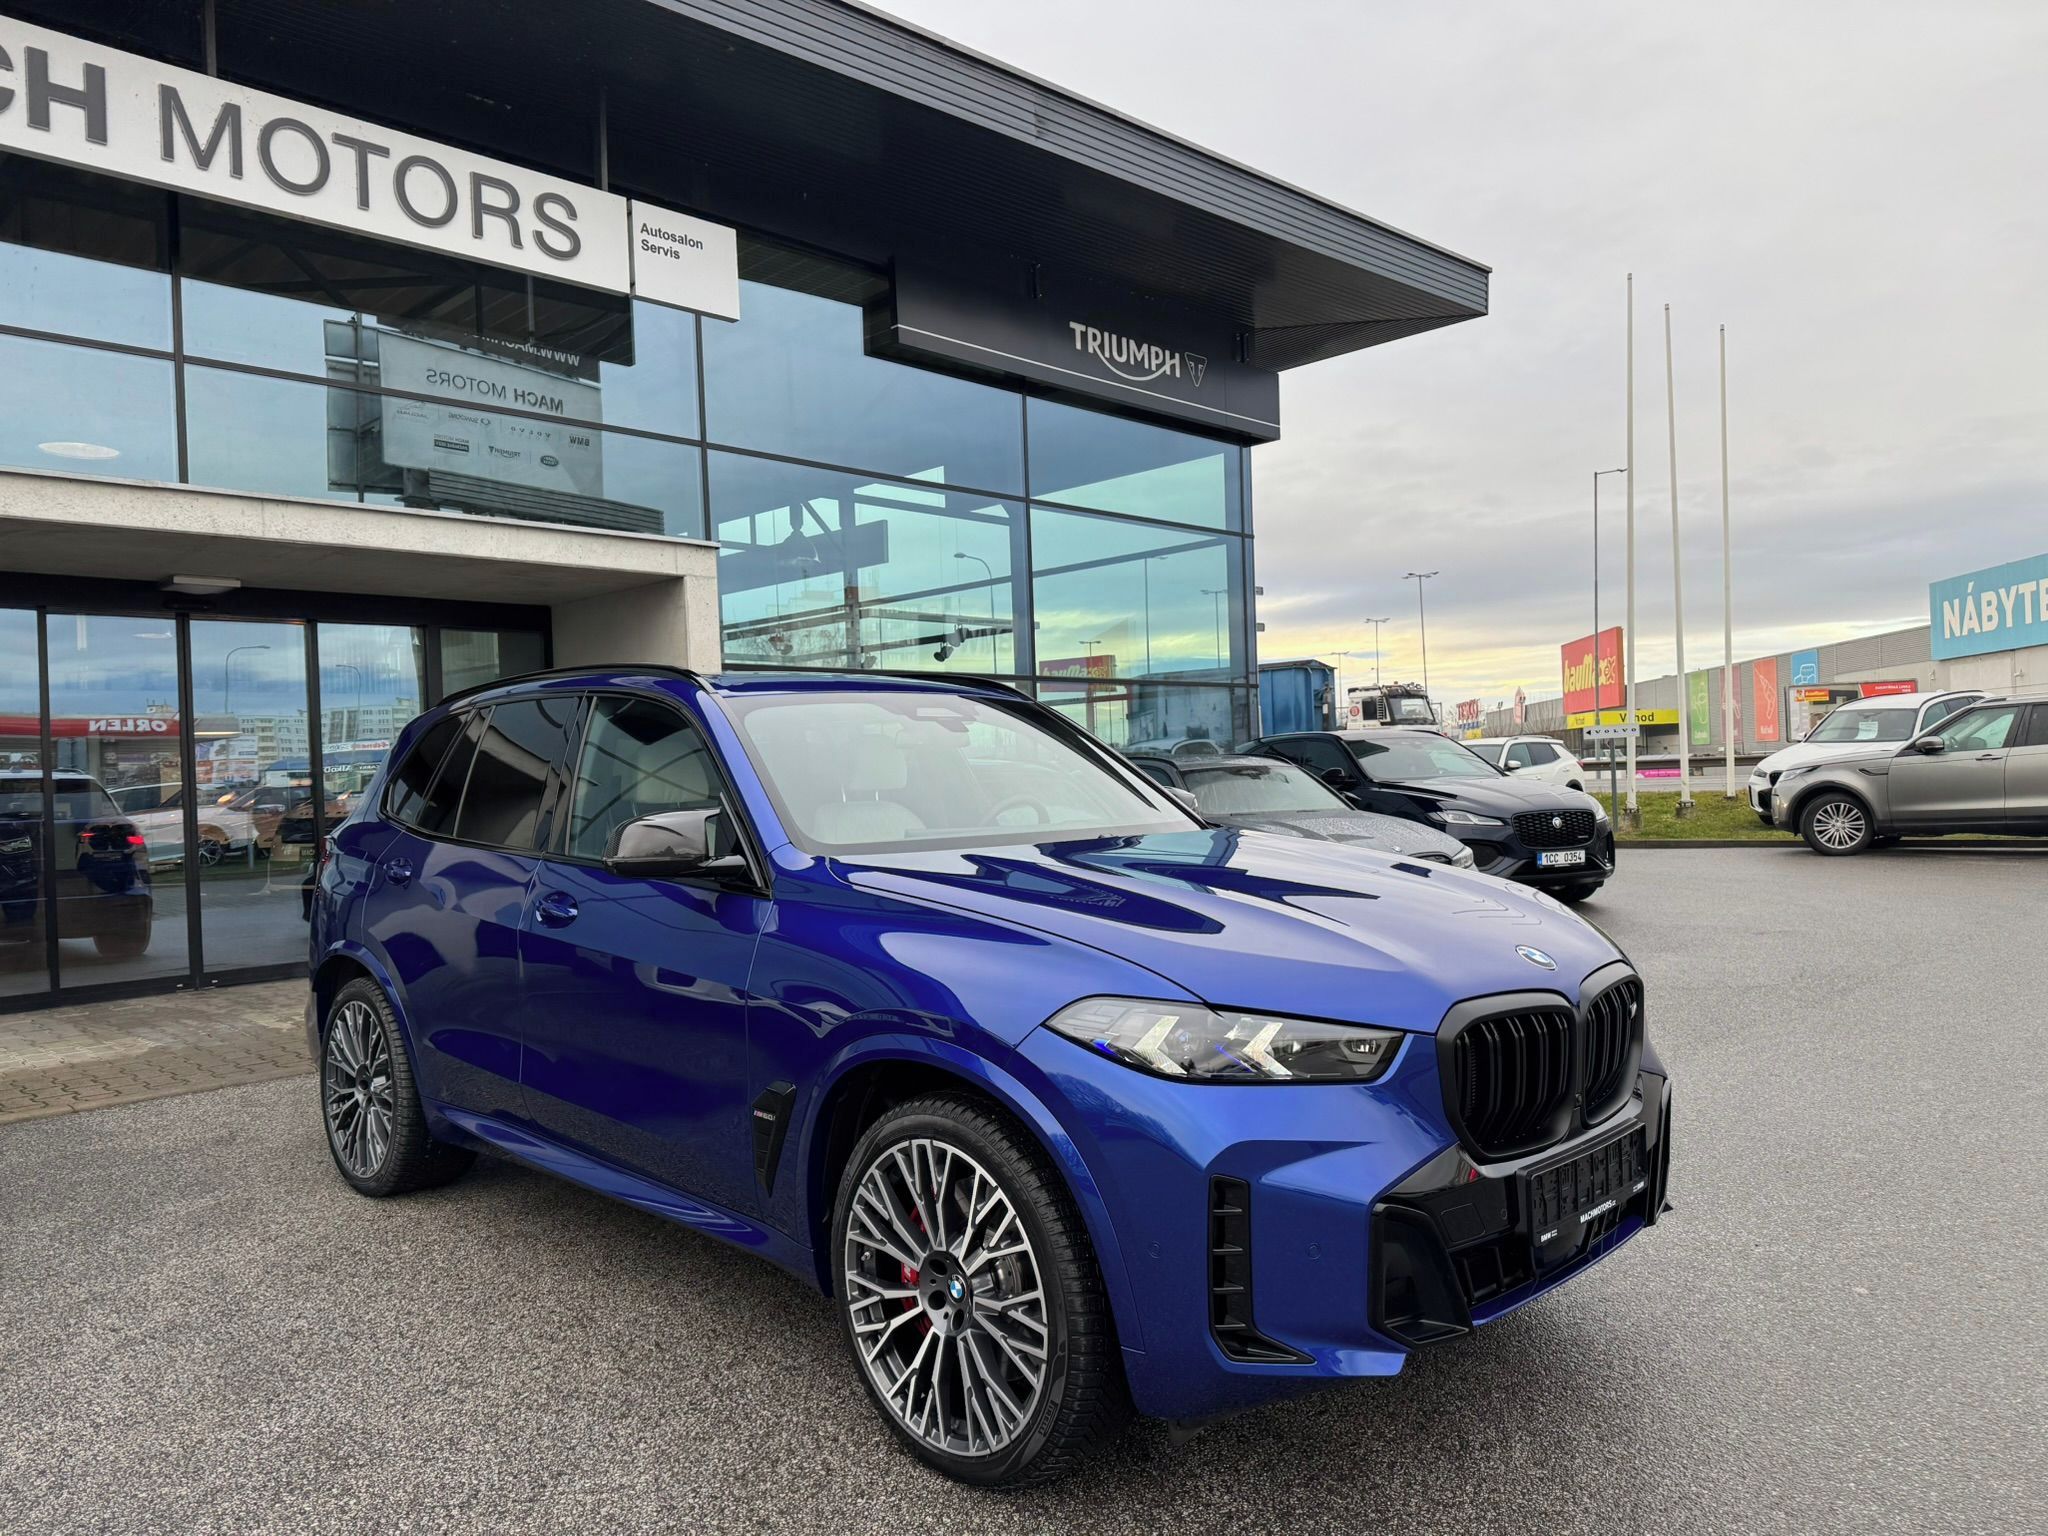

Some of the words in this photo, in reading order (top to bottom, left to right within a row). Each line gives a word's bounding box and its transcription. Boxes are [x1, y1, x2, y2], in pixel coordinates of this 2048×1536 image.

[158, 83, 582, 261] MOTORS
[640, 222, 703, 250] Autosalon
[641, 238, 680, 260] Servis
[1069, 320, 1181, 381] TRIUMPH
[1943, 577, 2048, 640] NÁBYTE
[1619, 711, 1655, 723] Vhod
[1544, 853, 1559, 864] 1CC
[1564, 851, 1582, 862] 0354
